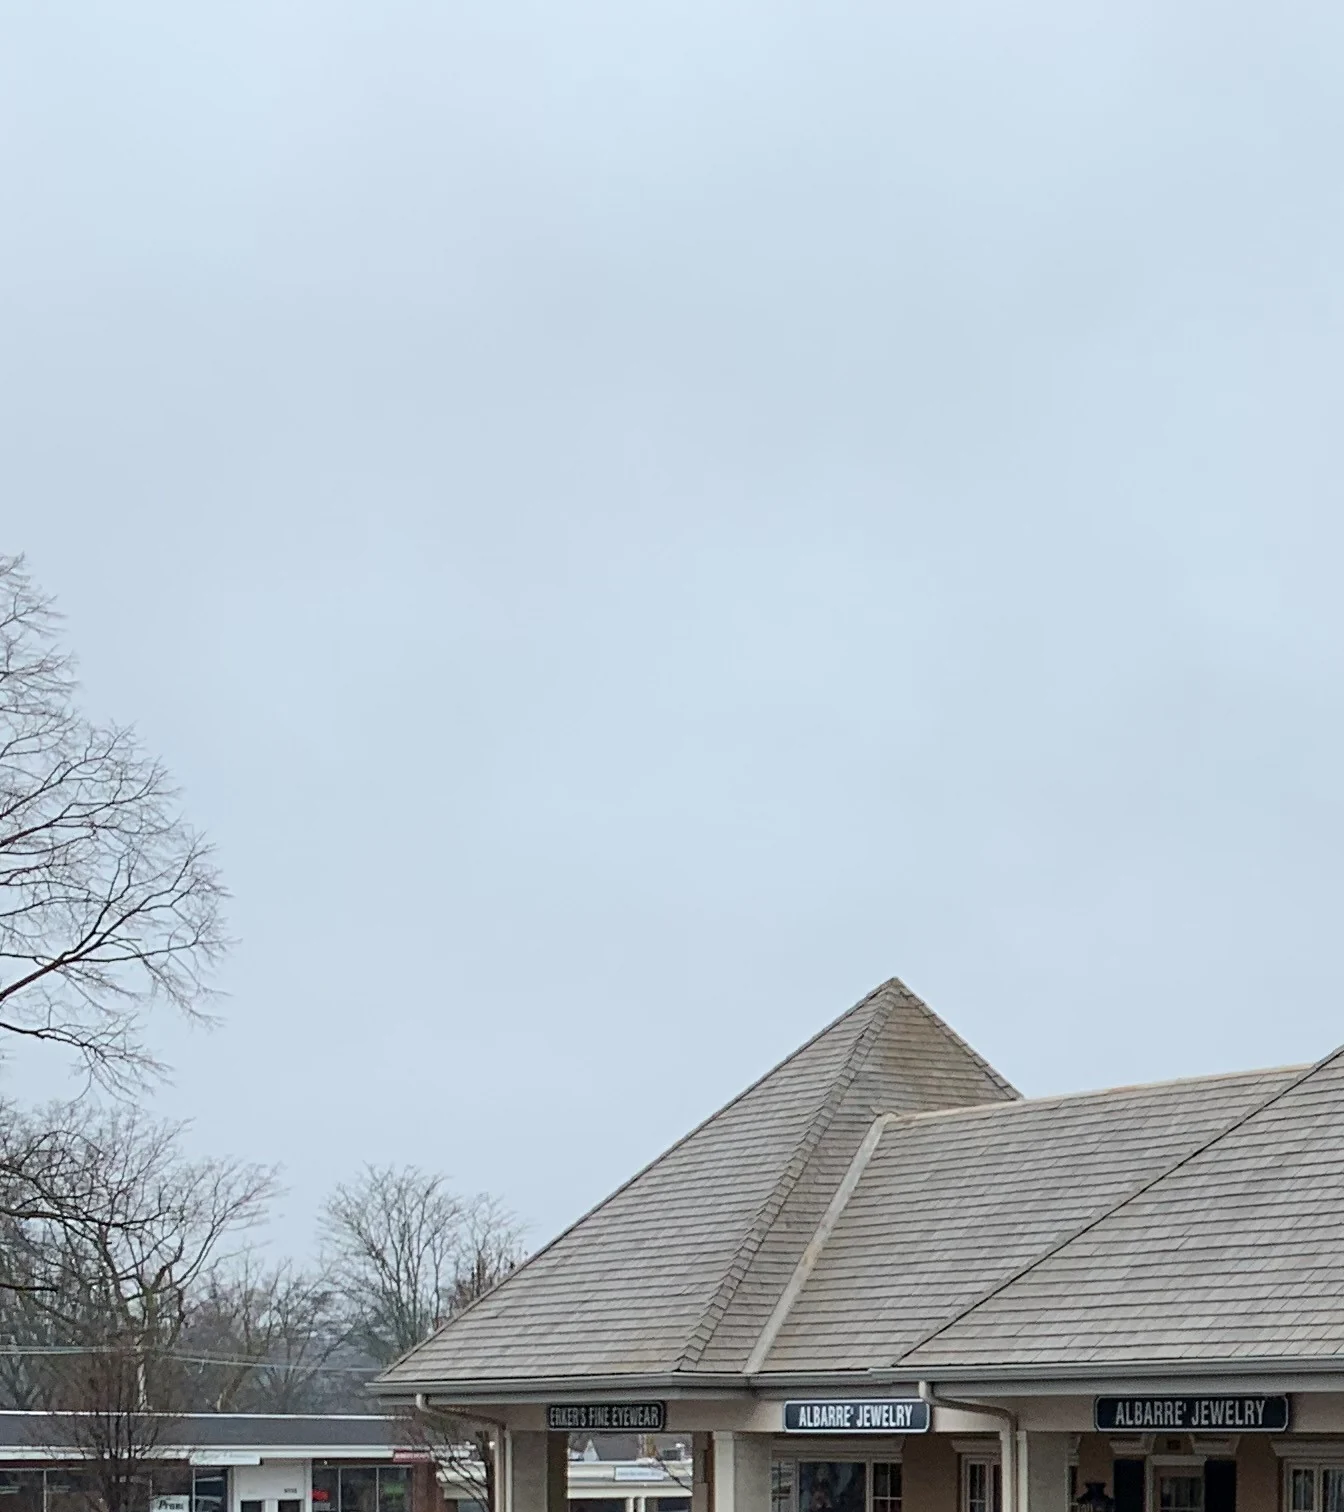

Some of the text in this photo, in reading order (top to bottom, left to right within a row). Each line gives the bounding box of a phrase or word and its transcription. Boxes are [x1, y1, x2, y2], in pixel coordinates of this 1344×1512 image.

[588, 1406, 610, 1426] FINE
[611, 1406, 659, 1426] EYEWEAR
[856, 1404, 913, 1427] JEWELRY
[1191, 1400, 1266, 1426] JEWELRY
